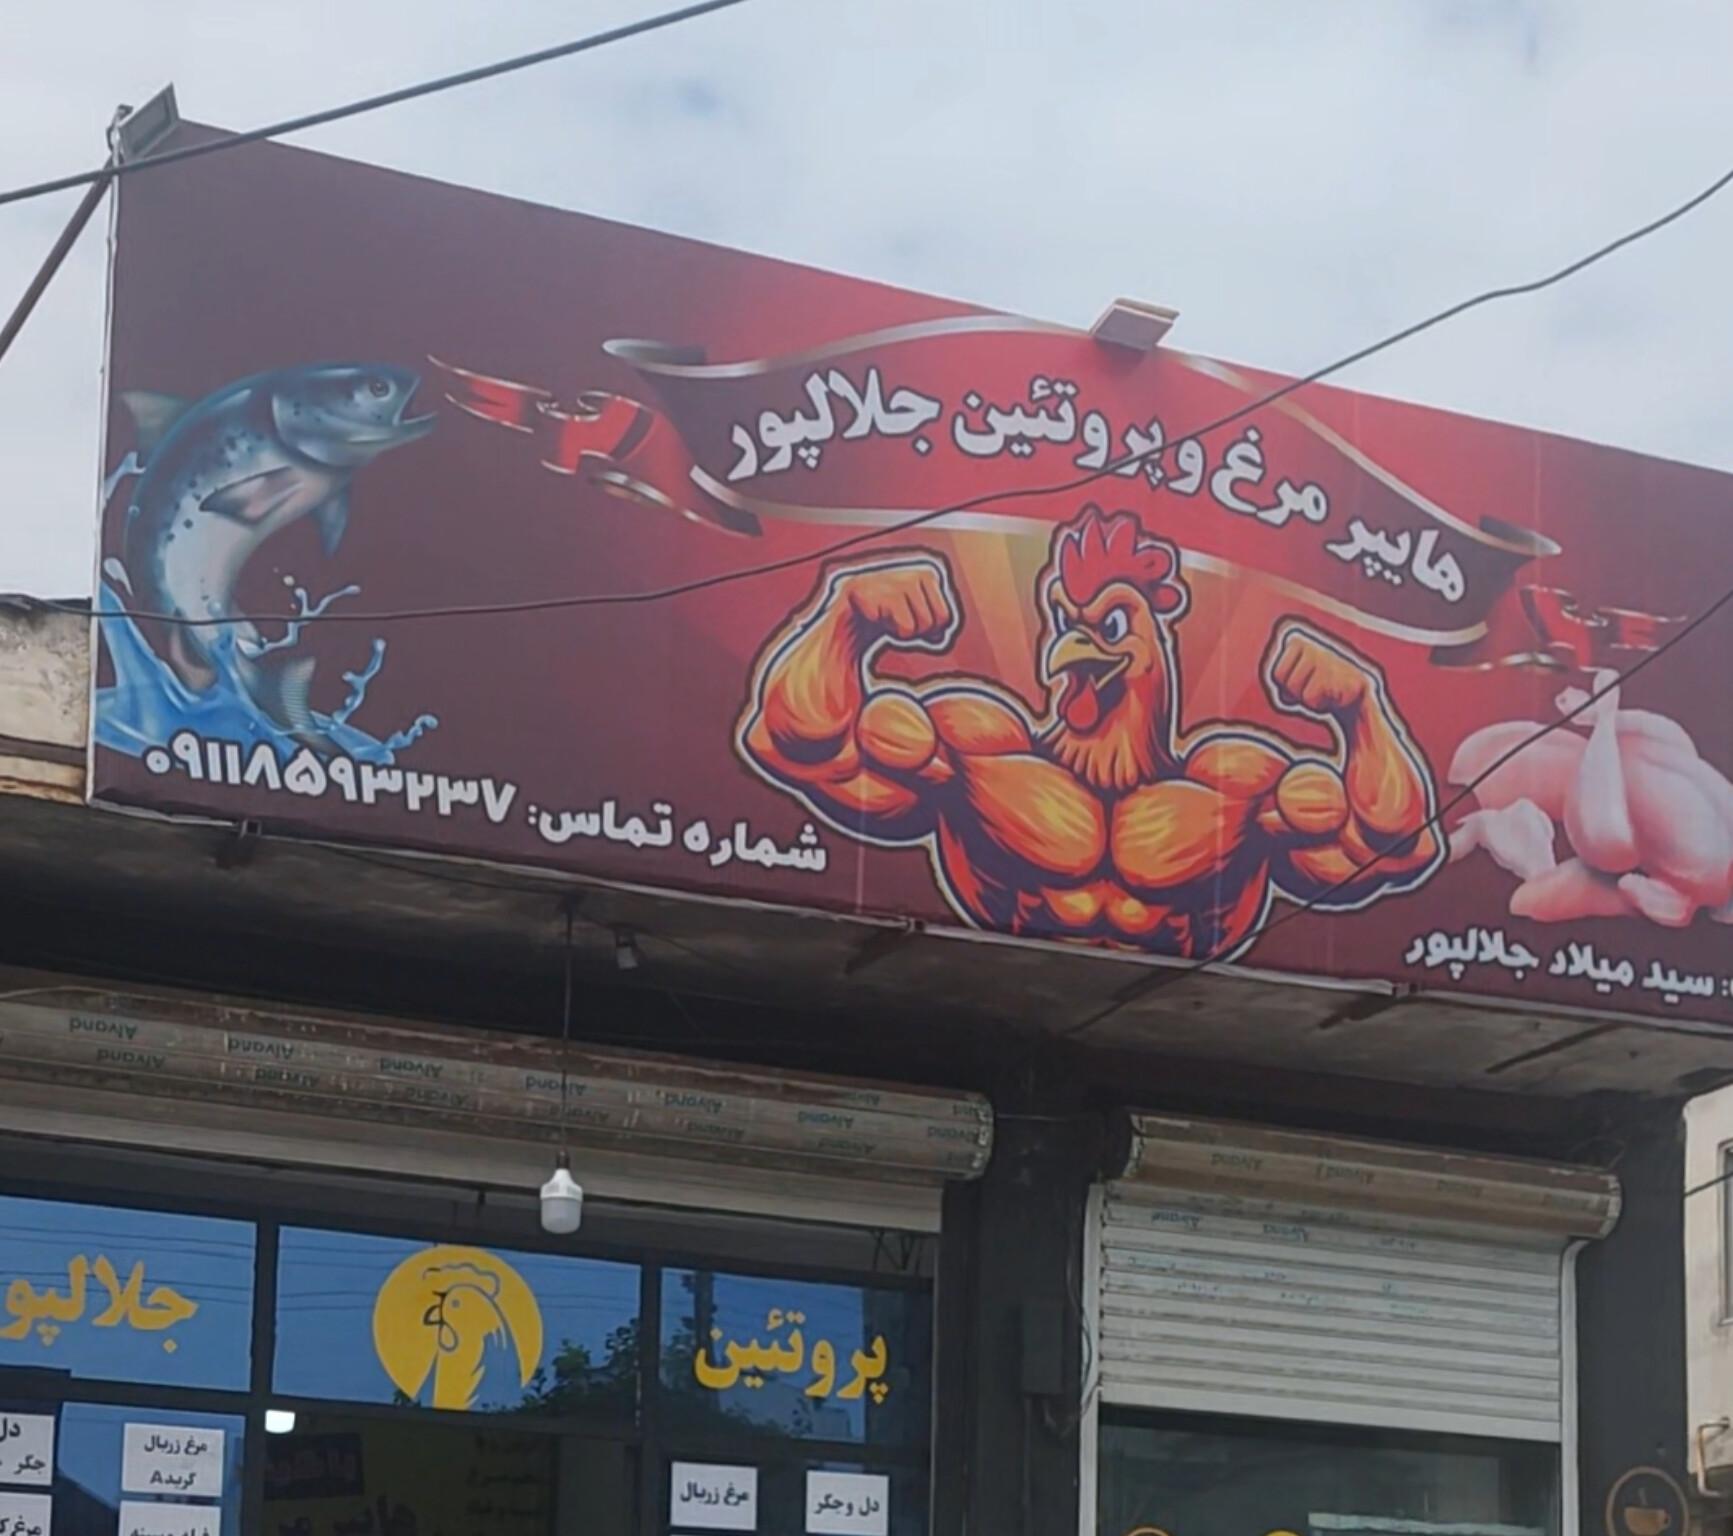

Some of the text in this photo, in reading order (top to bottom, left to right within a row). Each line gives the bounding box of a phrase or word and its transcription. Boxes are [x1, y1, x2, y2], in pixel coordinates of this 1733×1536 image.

[727, 368, 944, 480] جلالپور
[1209, 431, 1331, 525] مرغ
[1327, 512, 1469, 601] هایپر
[146, 731, 828, 873] شماره تماس: ۰۹۱۱۸۵۹۳۲۳۷
[1405, 927, 1540, 981] جلالپور
[1549, 942, 1635, 993] میلاد
[1642, 961, 1715, 1003] سید
[69, 1016, 138, 1040] Alvand
[227, 1036, 294, 1060] Alvand
[97, 1047, 166, 1070] Alvand
[379, 1056, 444, 1080] Alvand
[797, 1109, 856, 1131] Alvand
[0, 1254, 199, 1353] جلالپو
[694, 1307, 889, 1404] پروتئین
[183, 1433, 208, 1456] مرغ
[723, 1481, 749, 1506] مرغ
[858, 1496, 880, 1516] دل
